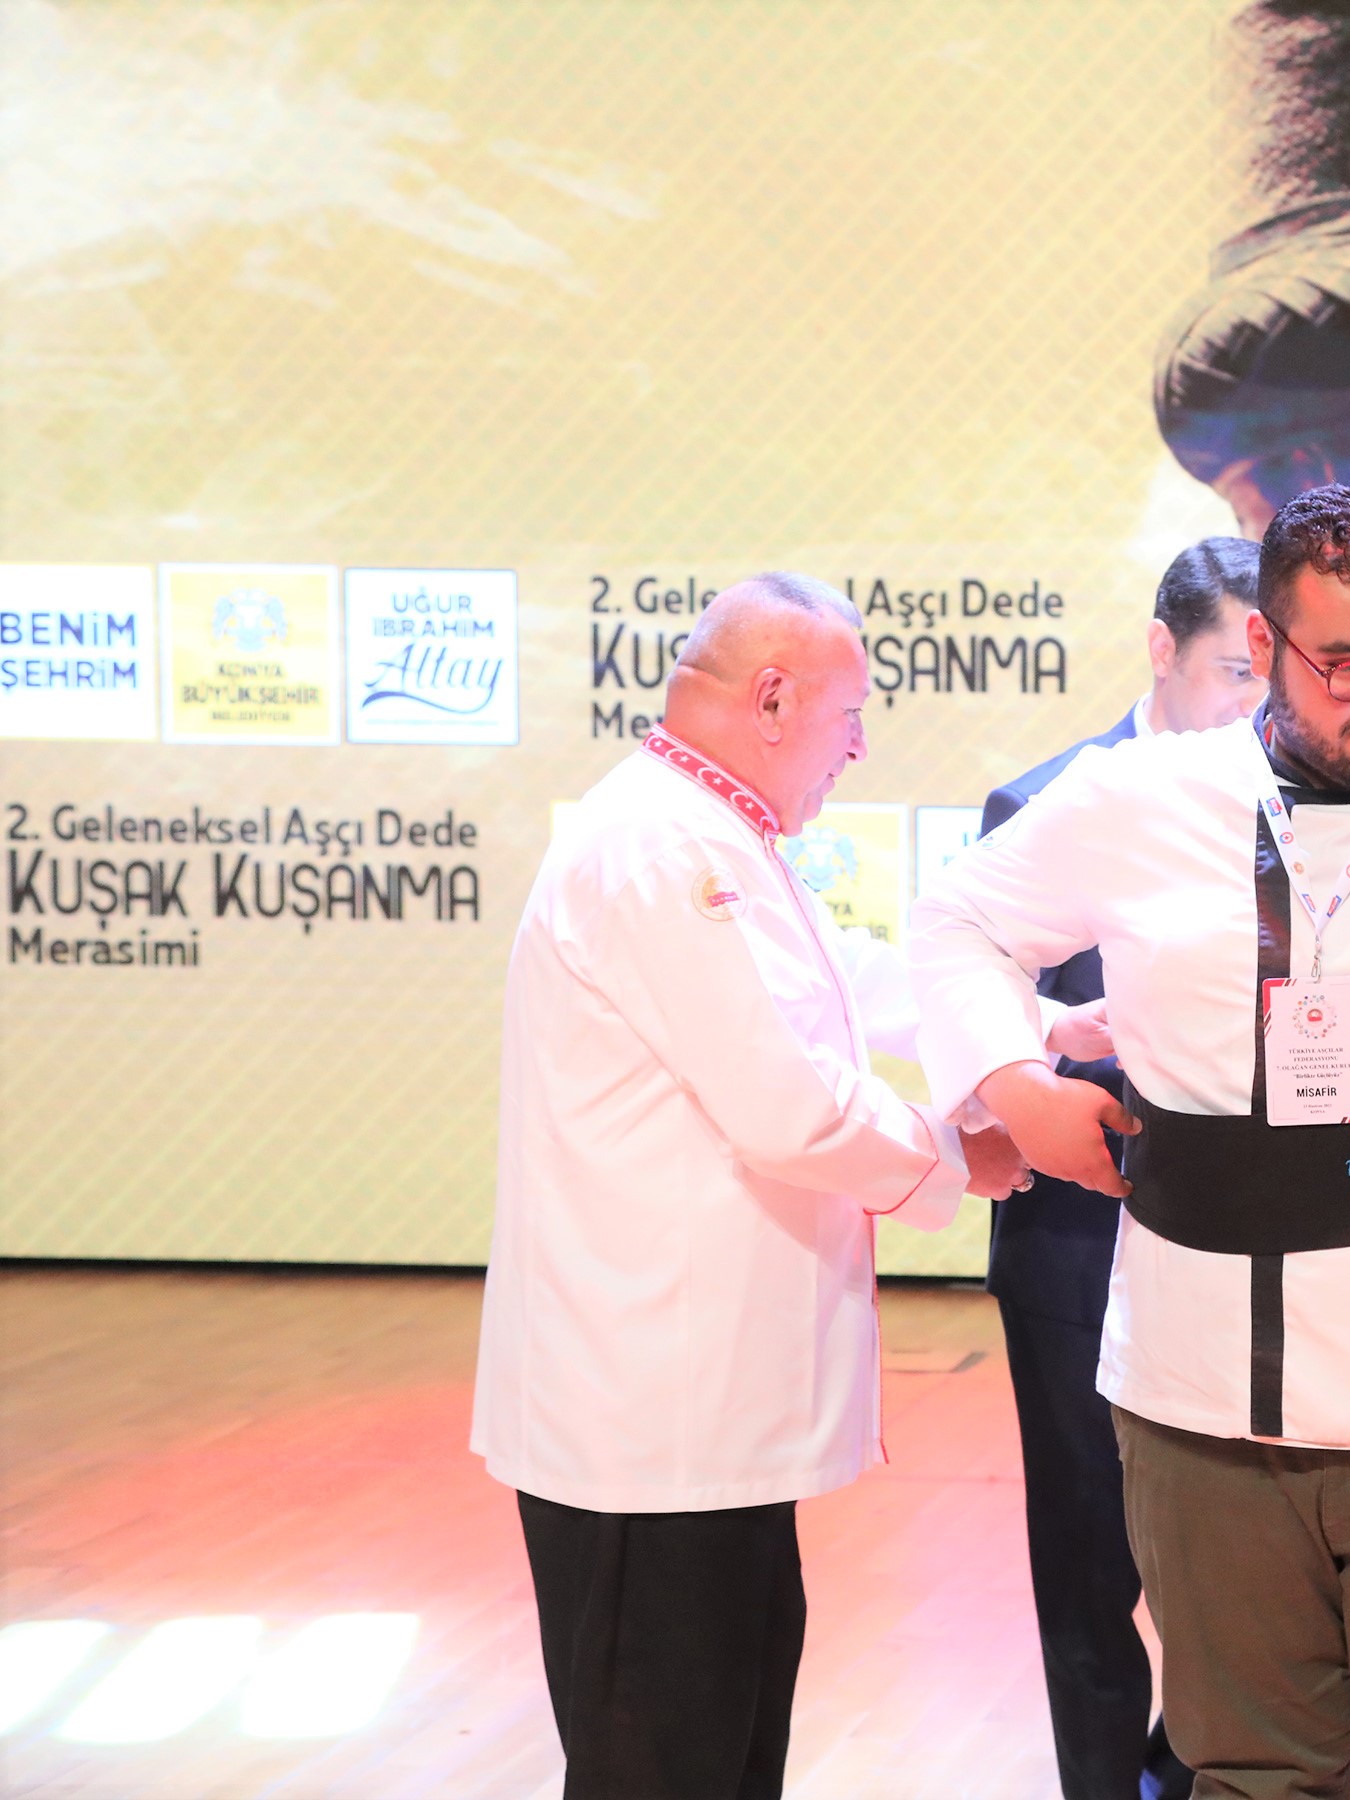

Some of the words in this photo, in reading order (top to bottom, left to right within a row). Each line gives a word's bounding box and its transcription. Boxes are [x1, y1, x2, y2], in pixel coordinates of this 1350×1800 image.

[391, 586, 473, 614] UĞUR
[590, 576, 622, 614] 2.
[866, 579, 948, 629] Aşçı
[961, 578, 1065, 618] Dede
[362, 642, 504, 714] Altay
[8, 803, 40, 841] 2.
[53, 803, 271, 844] Geleneksel
[282, 807, 363, 857] Aşçı
[377, 808, 479, 847] Dede
[9, 849, 188, 931] KUŞAK
[213, 852, 479, 935] KUŞANMA
[9, 926, 200, 966] Merasimi
[1296, 1084, 1337, 1098] MİSAFİR
